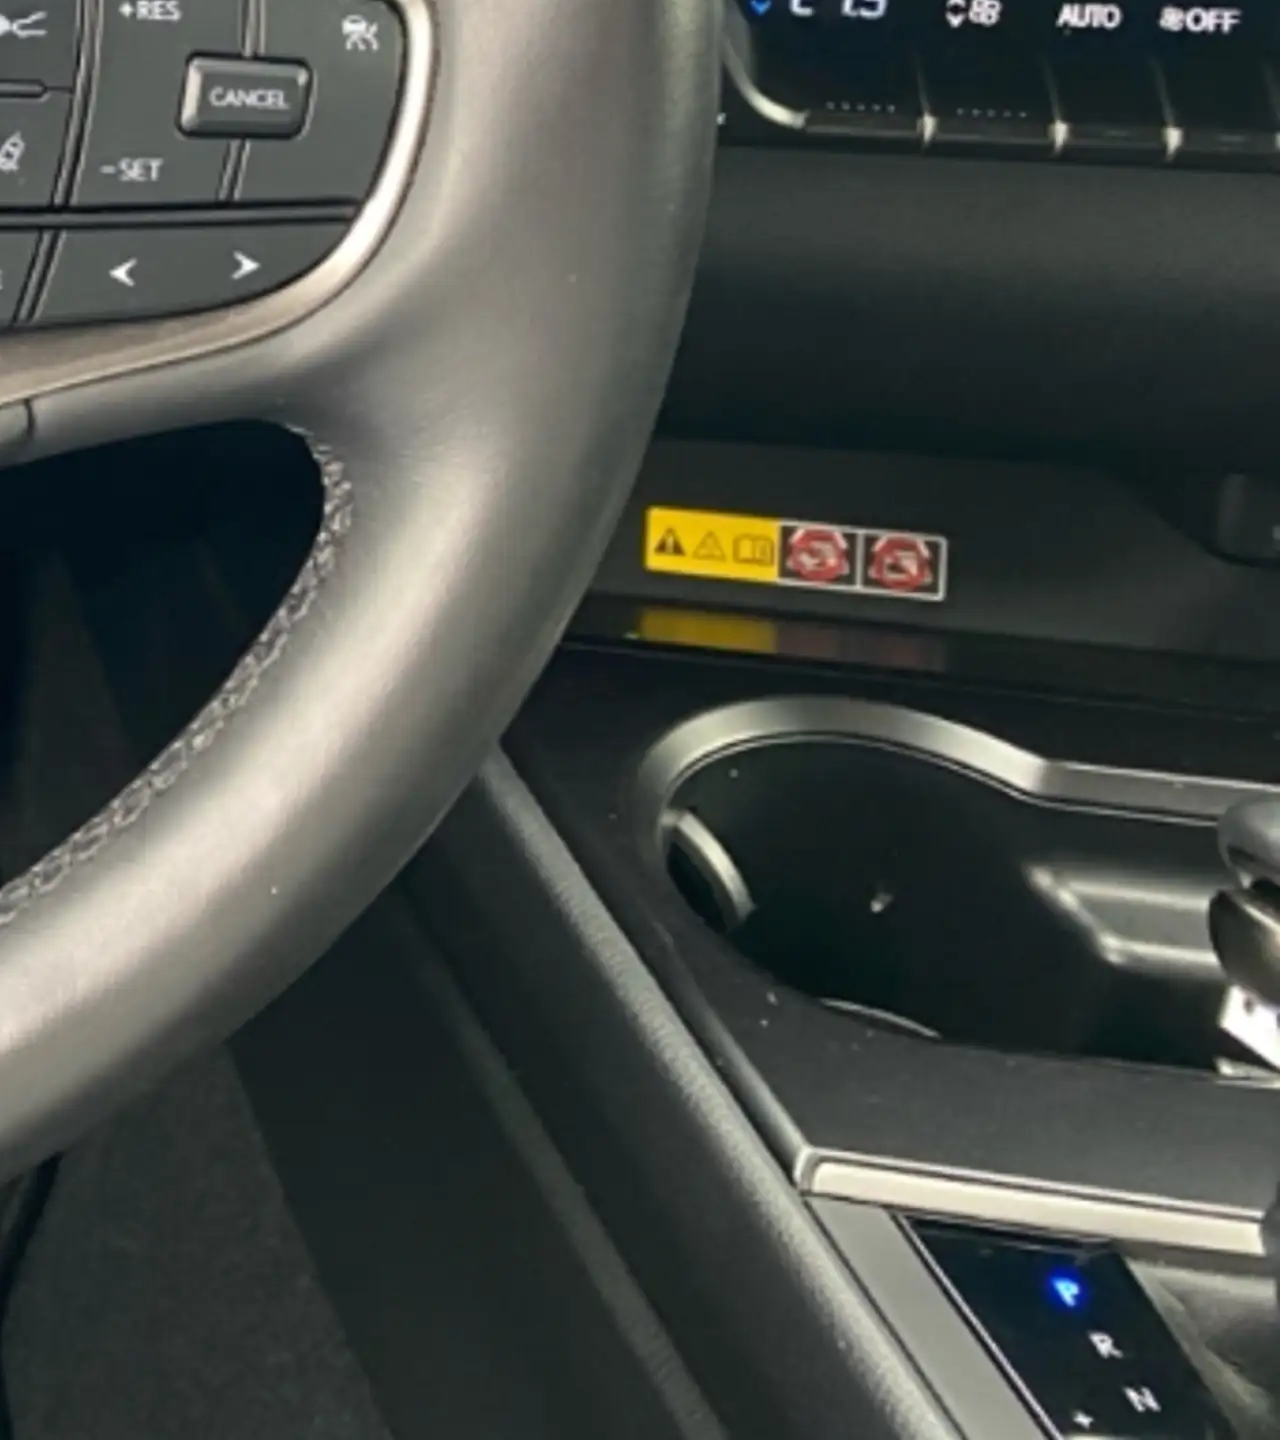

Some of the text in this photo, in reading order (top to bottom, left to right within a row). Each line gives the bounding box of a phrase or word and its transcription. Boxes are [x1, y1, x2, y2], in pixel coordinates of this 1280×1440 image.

[1057, 3, 1123, 30] AUTO
[1186, 7, 1241, 34] OFF
[209, 86, 290, 111] CANCEL
